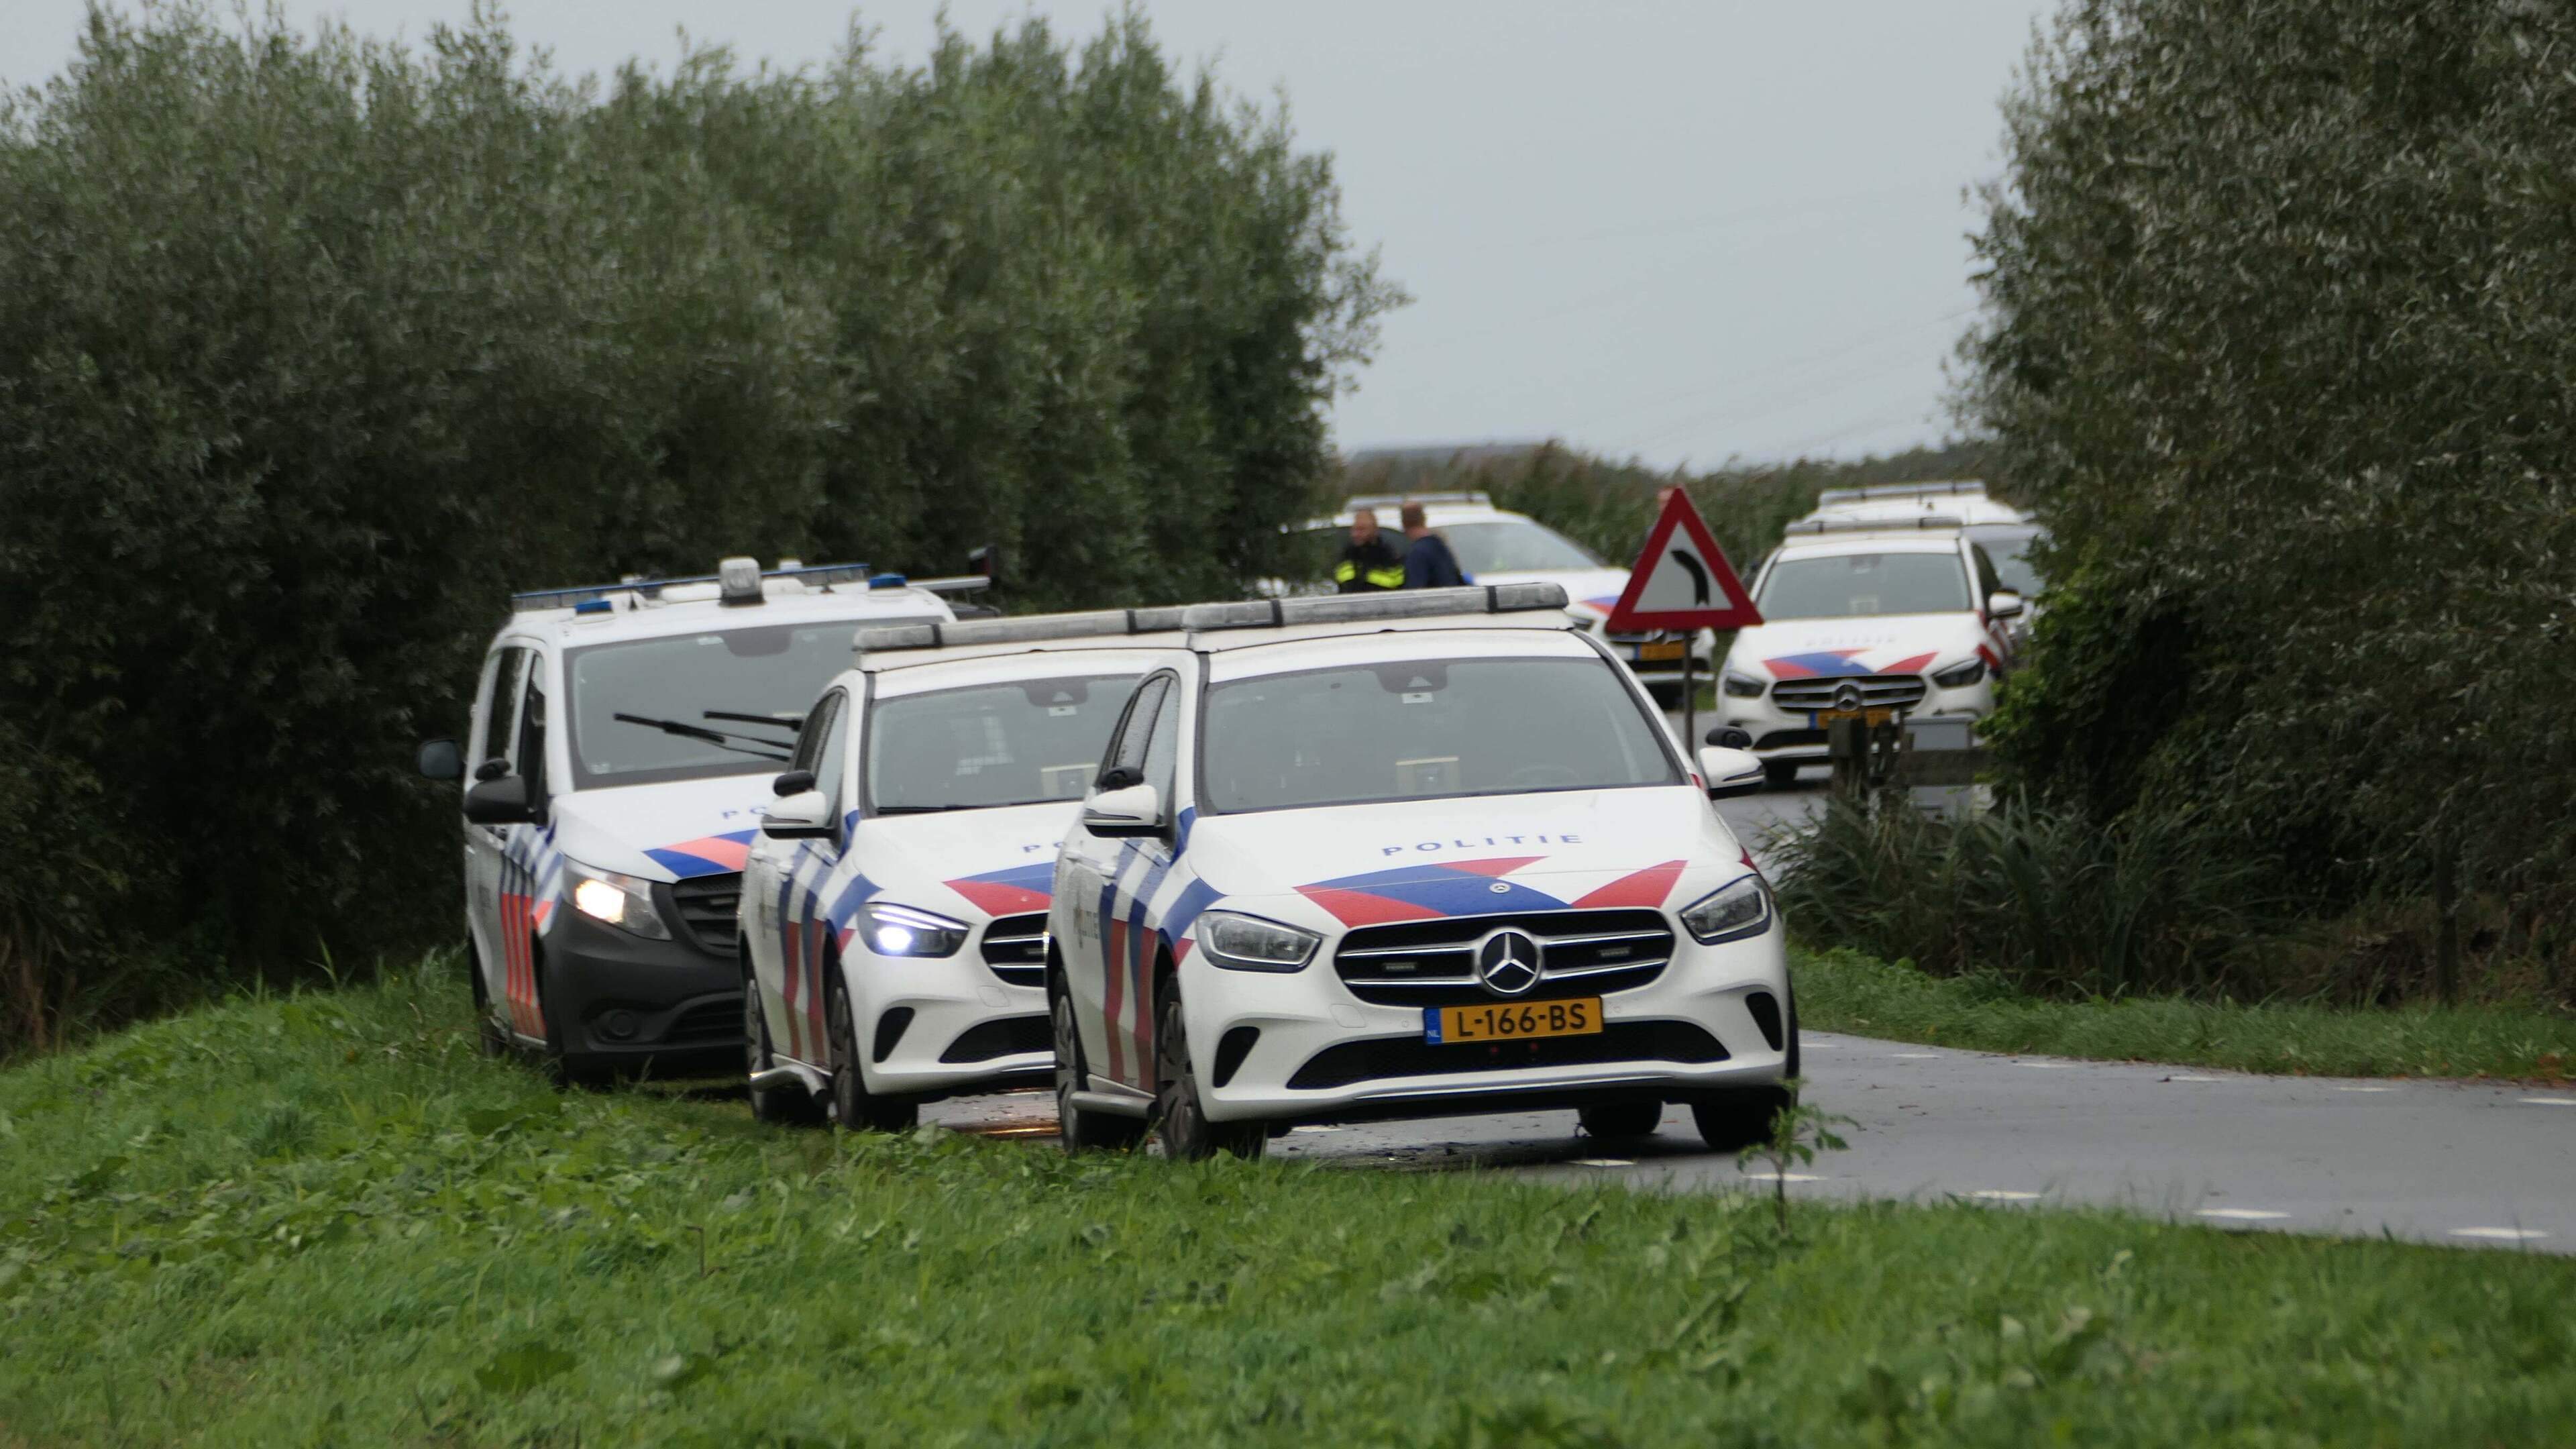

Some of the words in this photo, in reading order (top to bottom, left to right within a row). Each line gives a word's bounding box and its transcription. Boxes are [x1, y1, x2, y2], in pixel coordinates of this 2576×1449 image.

[1382, 835, 1582, 856] POLITIE
[1457, 1003, 1586, 1037] L-166-BS
[1427, 1028, 1440, 1038] NL
